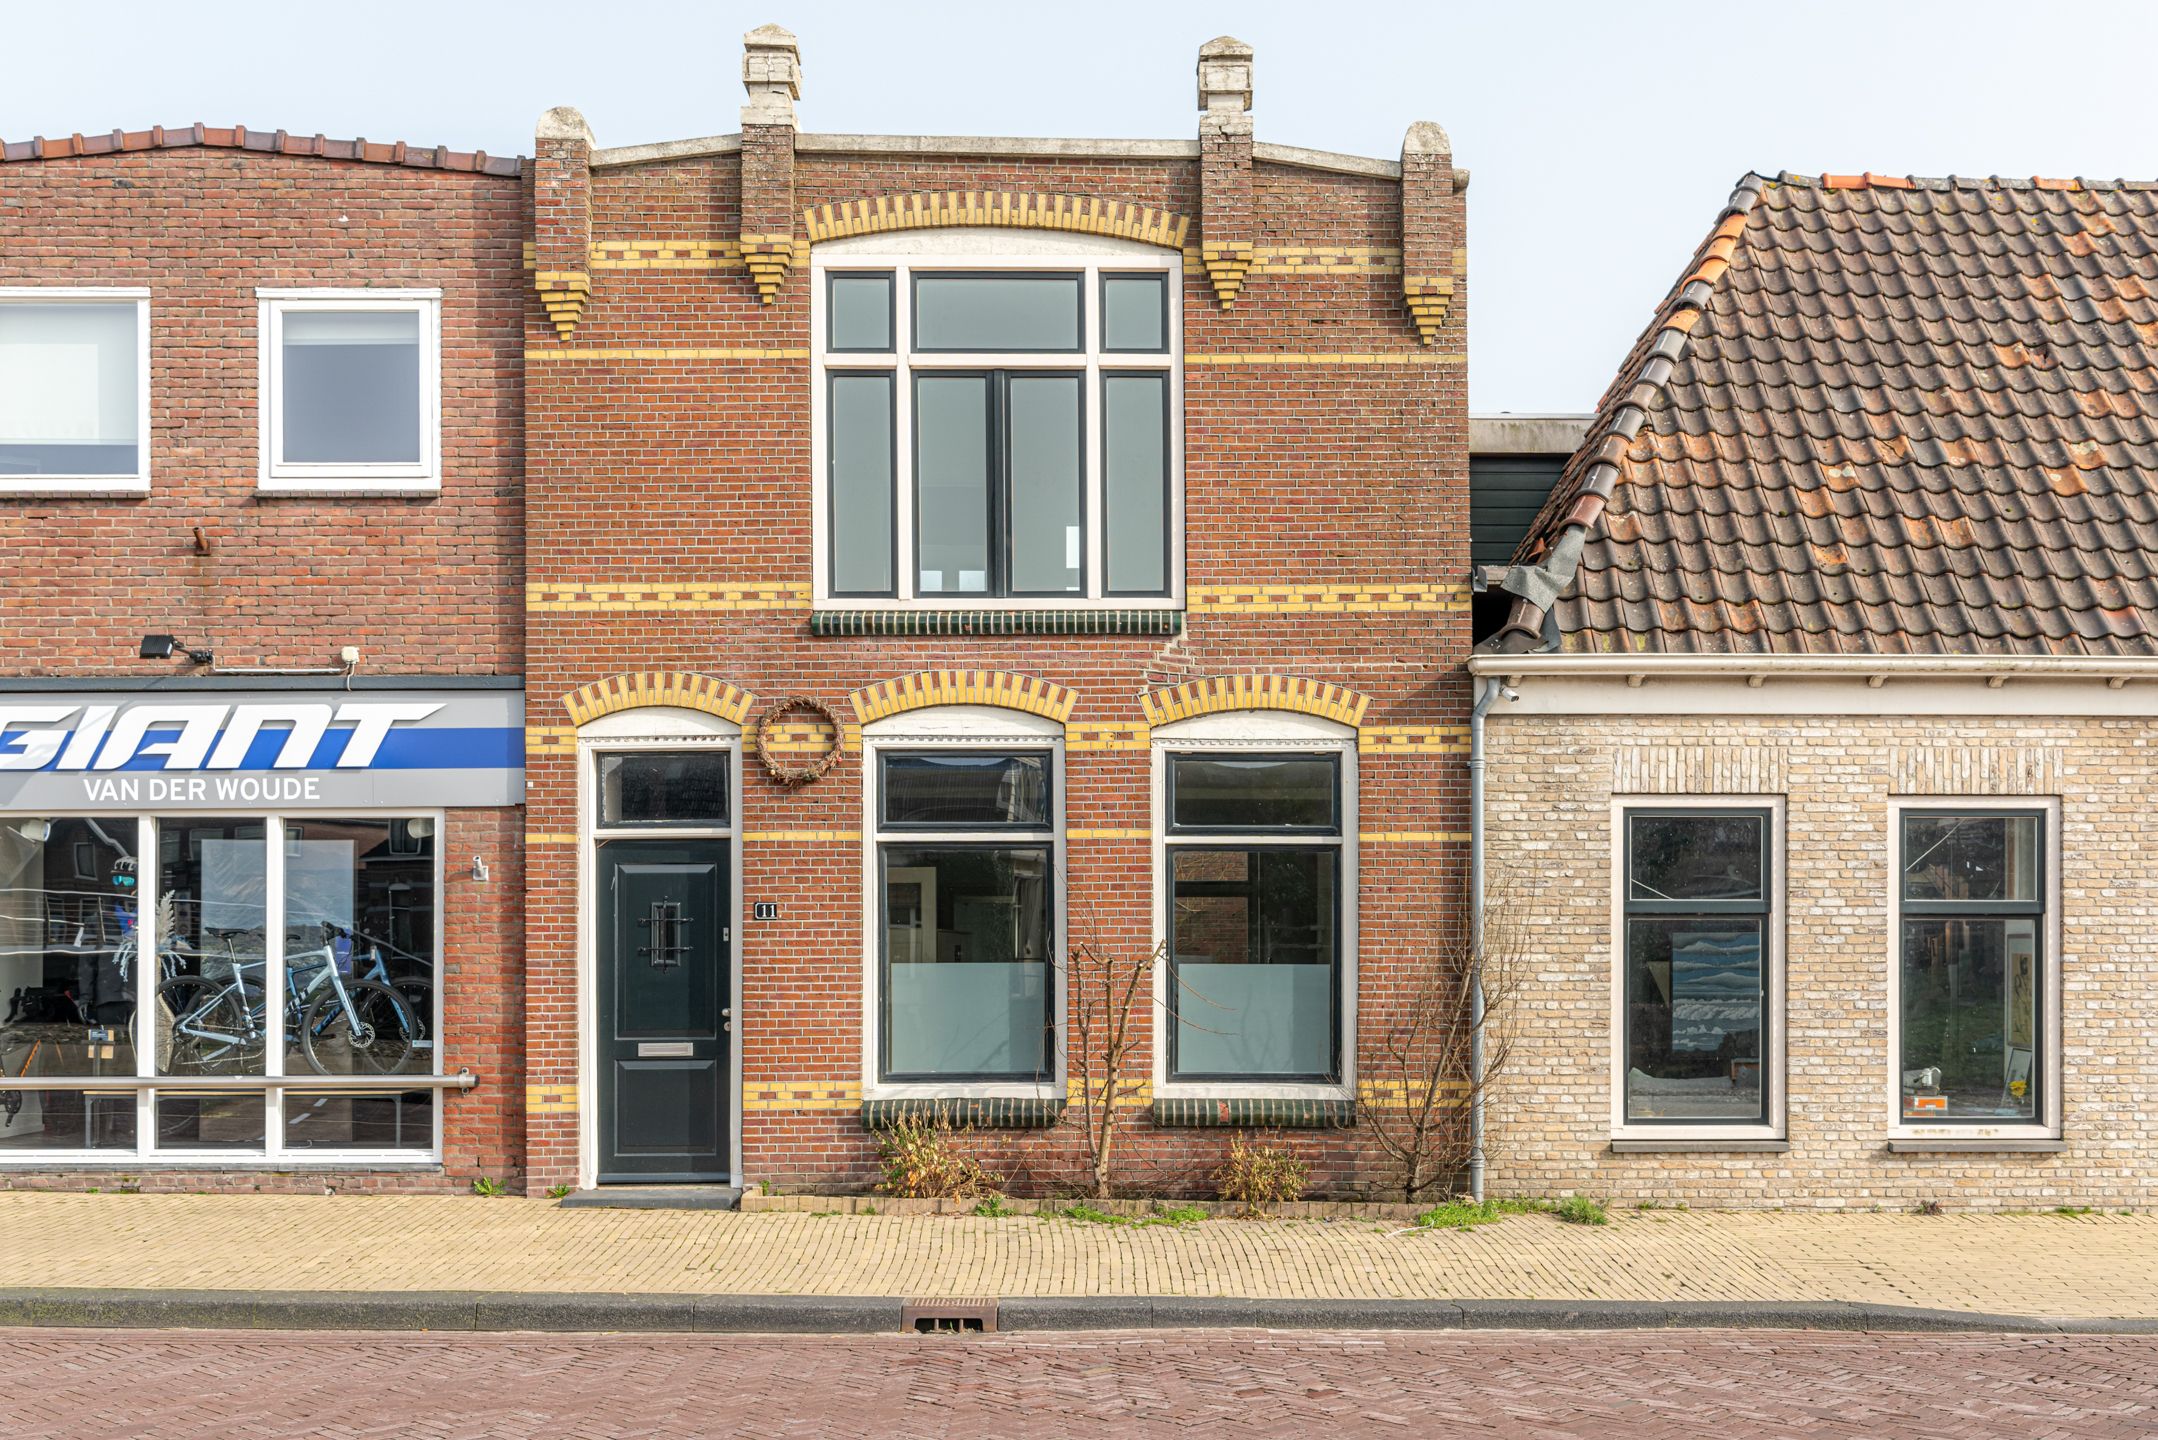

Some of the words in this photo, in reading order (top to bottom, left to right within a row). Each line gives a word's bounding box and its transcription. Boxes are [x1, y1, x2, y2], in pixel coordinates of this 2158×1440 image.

[83, 778, 139, 801] VAN
[150, 778, 206, 801] DER
[216, 778, 320, 800] WOUDE
[761, 904, 776, 918] 11
